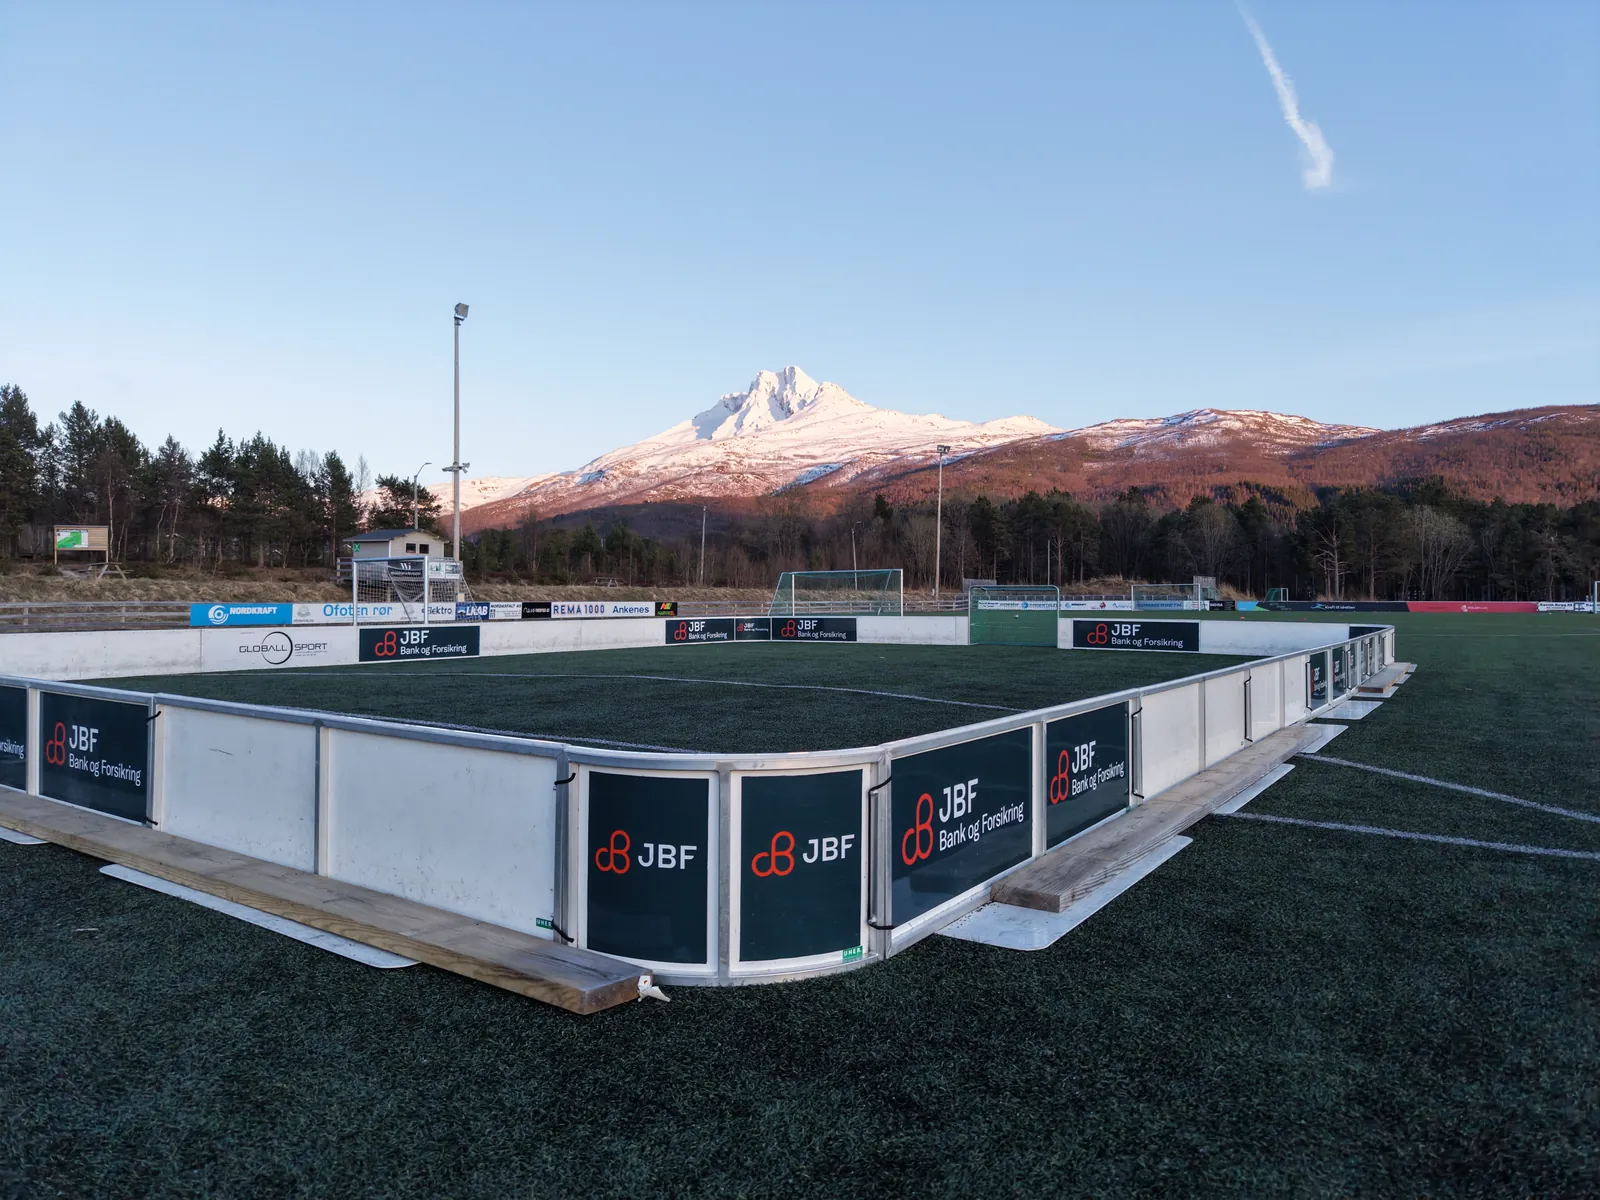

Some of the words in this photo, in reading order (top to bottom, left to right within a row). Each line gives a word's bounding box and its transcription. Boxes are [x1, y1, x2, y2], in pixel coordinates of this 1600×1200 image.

[230, 607, 277, 615] NORDKRAFT
[372, 605, 392, 616] rør
[553, 605, 582, 615] REMA
[584, 604, 605, 614] 1000
[612, 605, 649, 614] Ankenes
[688, 621, 706, 632] JBF
[797, 620, 817, 630] JBF
[1111, 624, 1141, 636] JBF
[400, 630, 430, 645] JBF
[701, 633, 707, 641] og
[706, 631, 728, 640] Forsikring
[819, 631, 847, 639] Forsikring
[239, 644, 287, 653] GLOBALL
[294, 643, 327, 651] SPORT
[1111, 637, 1131, 645] Bank
[1133, 639, 1142, 648] og
[1143, 637, 1184, 648] Forsikring
[400, 645, 420, 655] Bank
[421, 646, 430, 655] og
[431, 644, 467, 654] Forsikring
[69, 725, 99, 753] JBF
[0, 739, 24, 759] rsikring
[1071, 740, 1096, 774] JBF
[69, 753, 89, 771] Bank
[90, 761, 100, 777] og
[101, 759, 141, 787] Forsikring
[1072, 774, 1088, 796] Bank
[1089, 773, 1097, 791] og
[1097, 760, 1124, 784] Forsikring
[939, 777, 979, 823] JBF
[939, 822, 966, 852] Bank
[967, 819, 980, 842] og
[981, 801, 1024, 834] Forsikring
[802, 833, 855, 864] JBF
[637, 842, 698, 870] JBF
